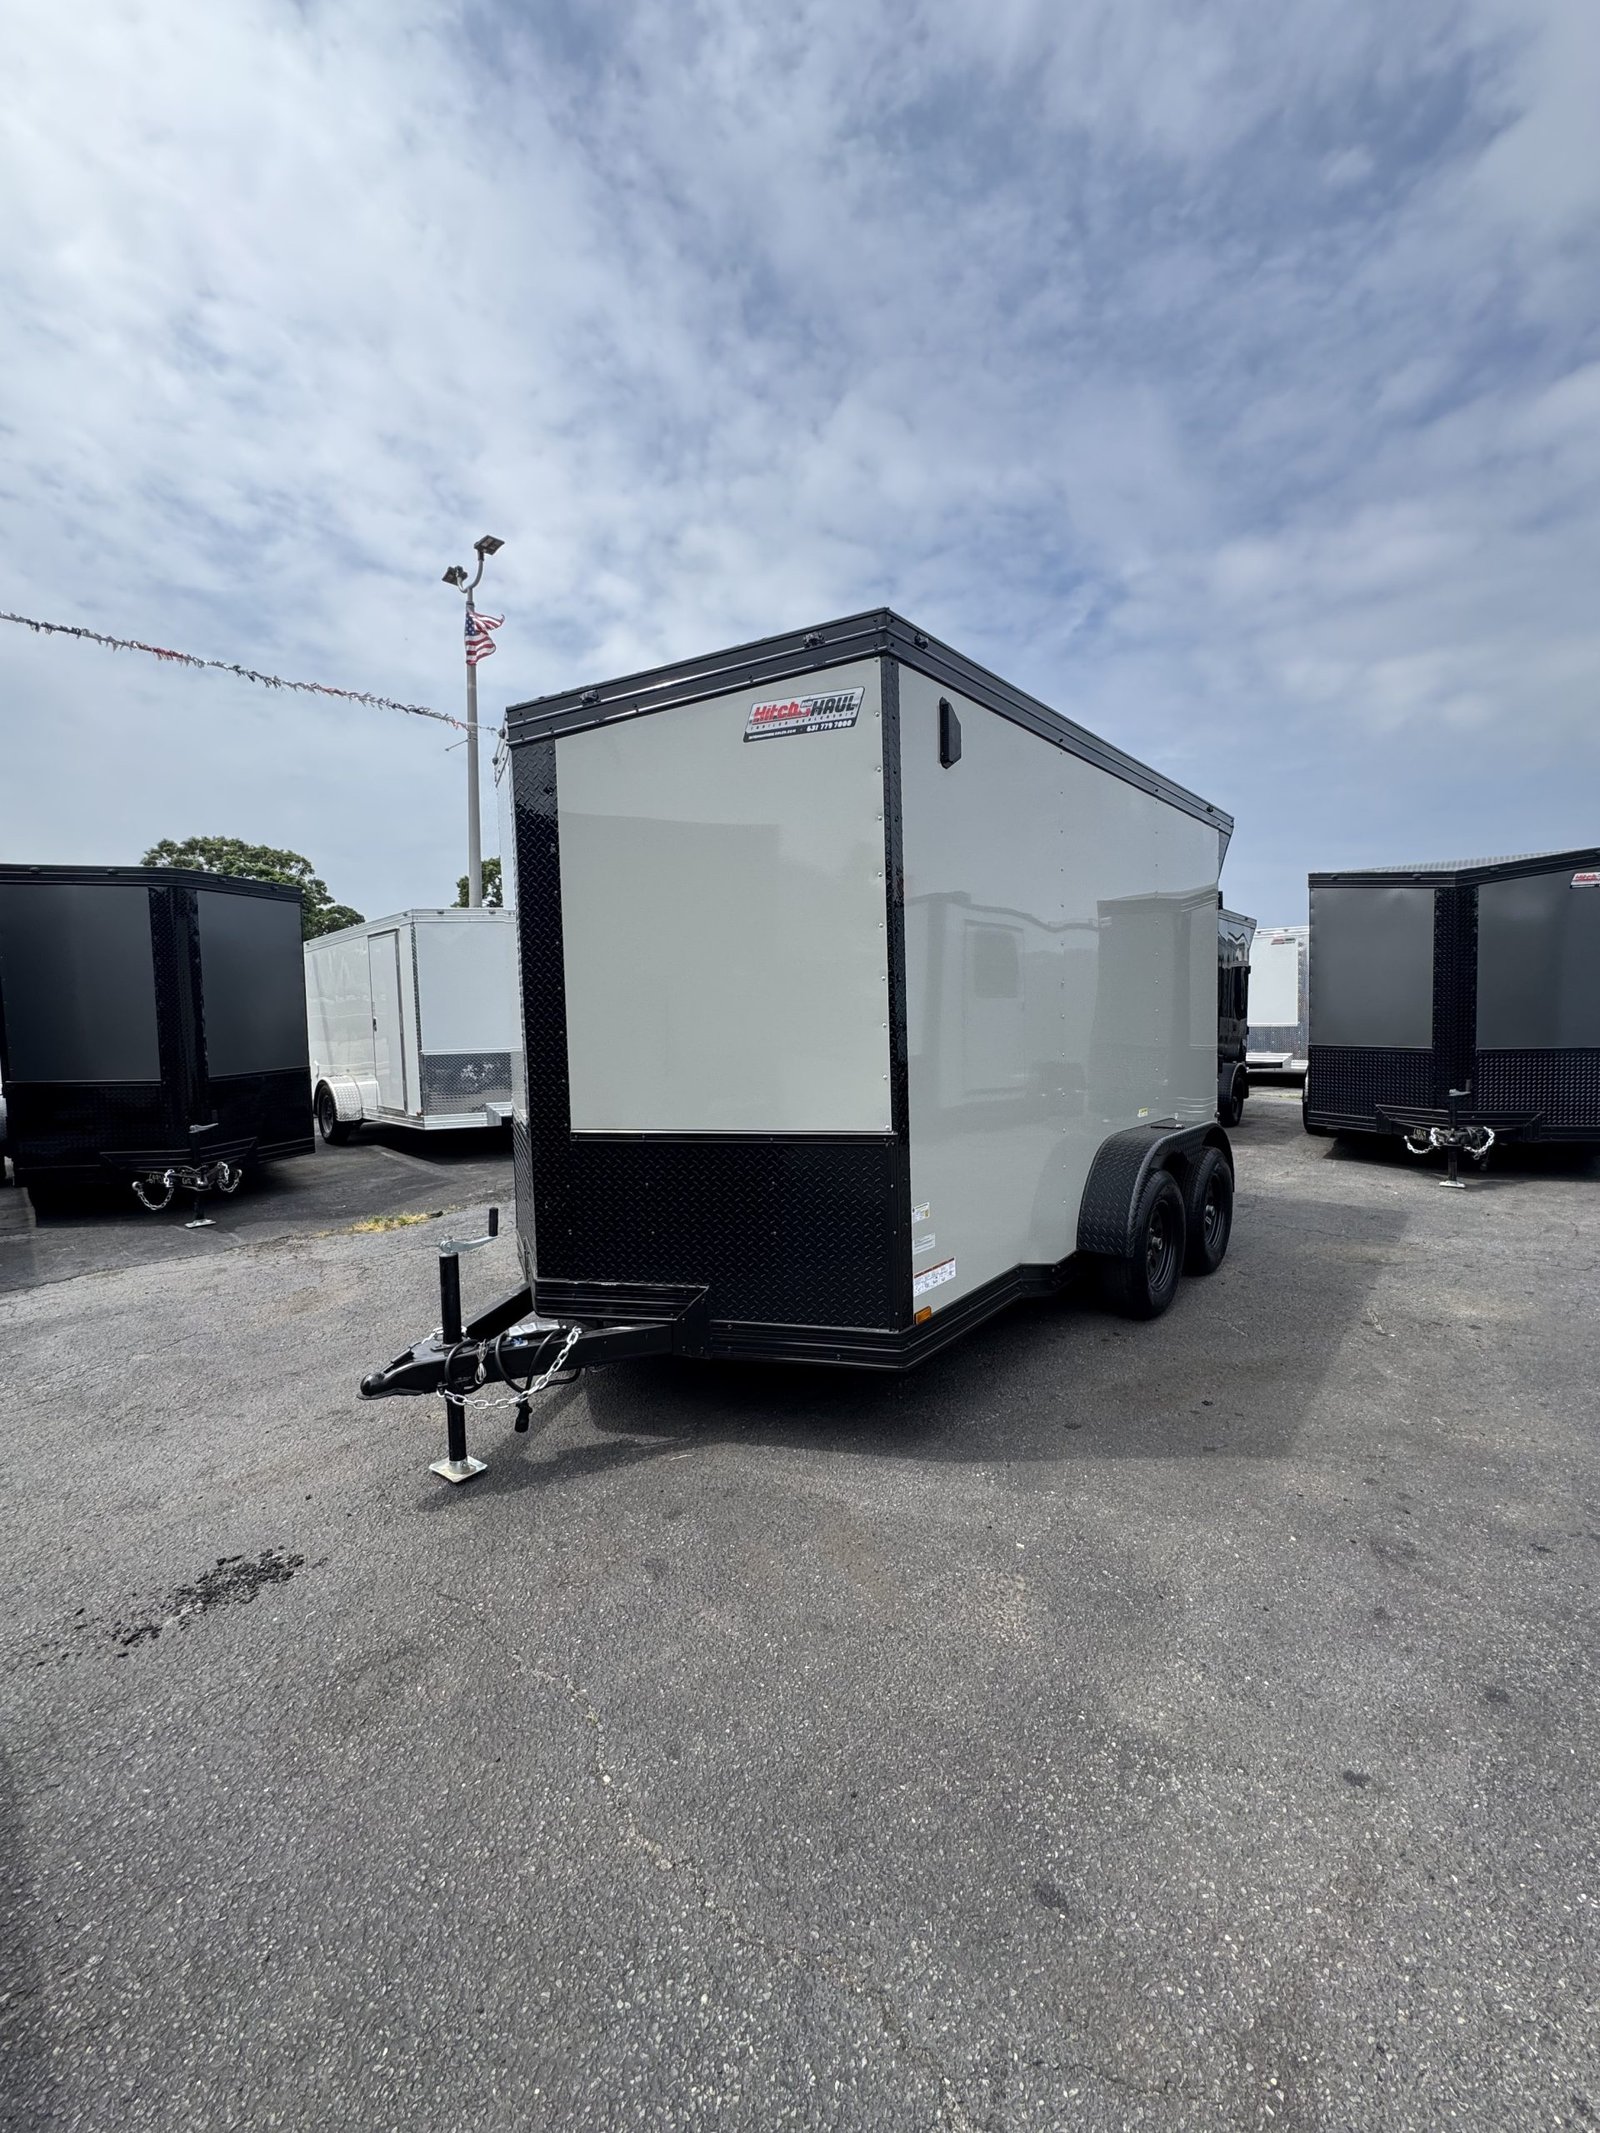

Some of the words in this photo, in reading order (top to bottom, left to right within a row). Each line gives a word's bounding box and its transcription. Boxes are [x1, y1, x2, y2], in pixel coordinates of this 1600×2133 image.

[753, 701, 806, 722] Hitch
[810, 695, 858, 716] HAUL
[806, 724, 819, 732] 631
[820, 722, 833, 730] 779
